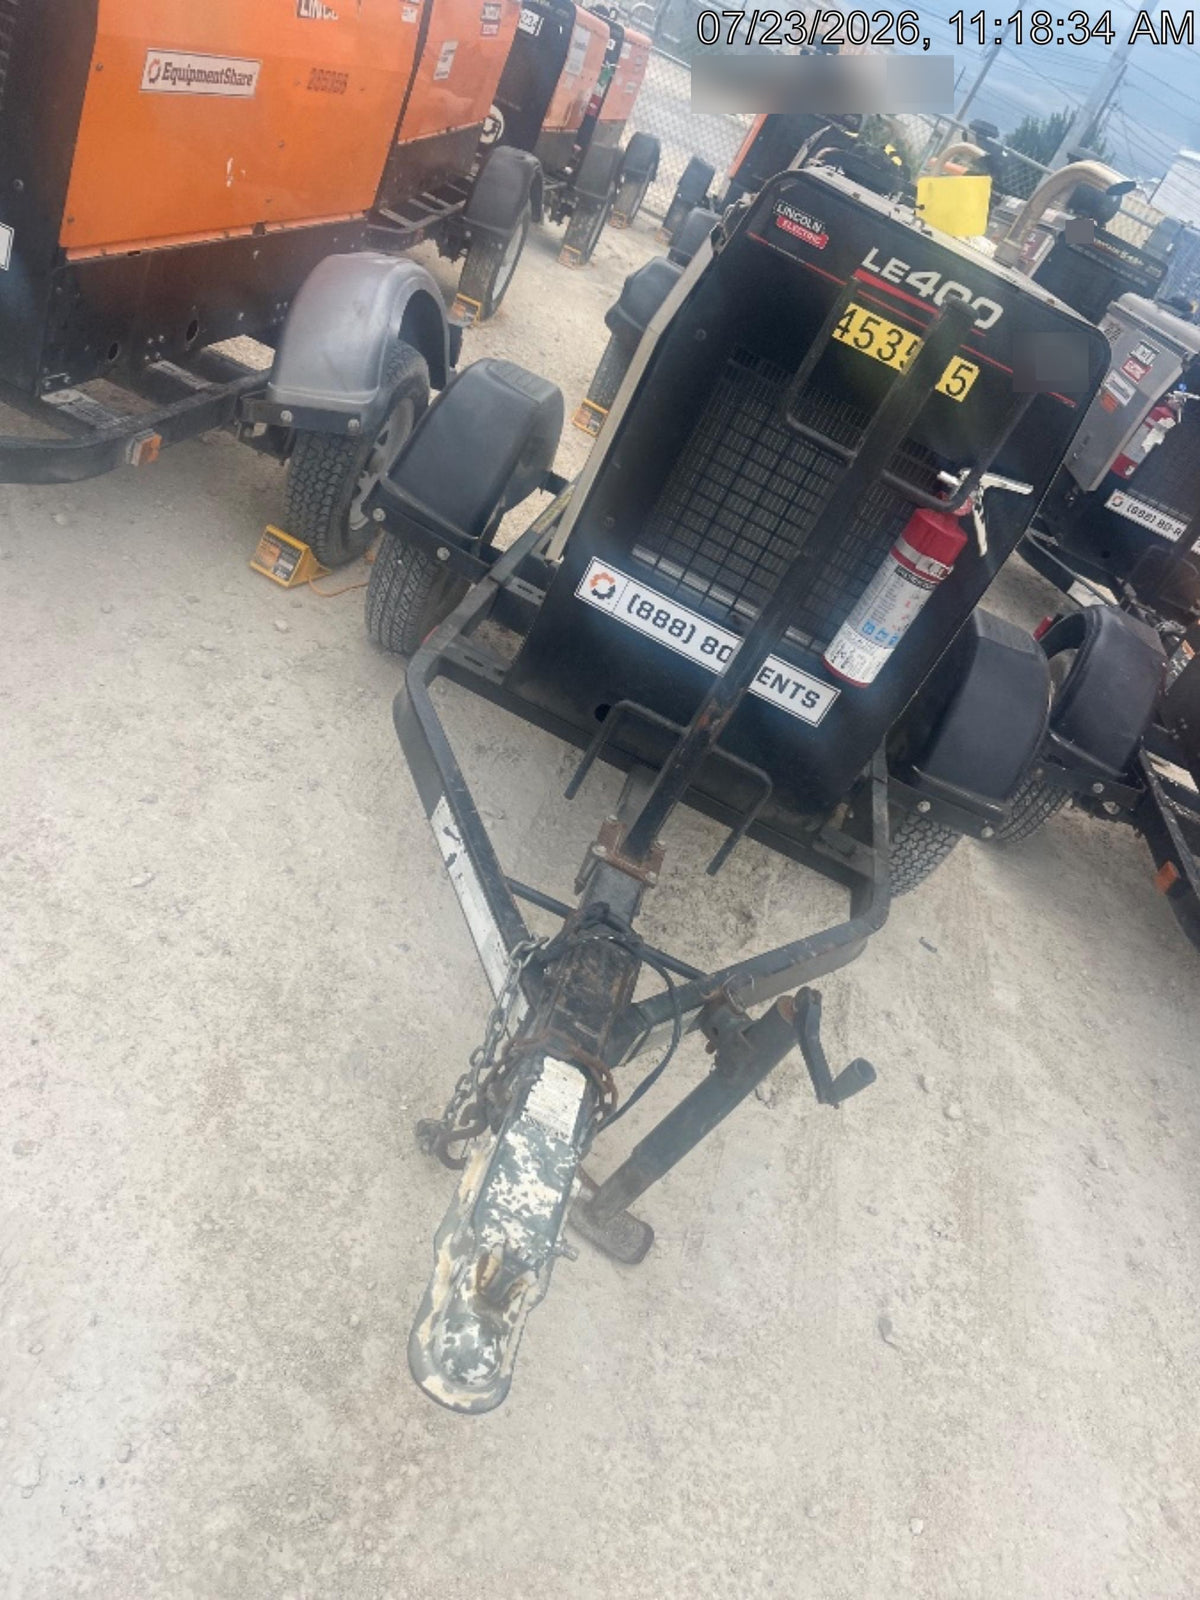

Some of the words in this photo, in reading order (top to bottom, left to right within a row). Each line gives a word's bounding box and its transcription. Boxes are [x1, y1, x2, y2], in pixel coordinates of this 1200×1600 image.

[161, 61, 253, 86] EquipmentShare
[776, 203, 823, 233] LINCOLN
[781, 219, 823, 245] ELECTRIC
[626, 594, 697, 645] (888)
